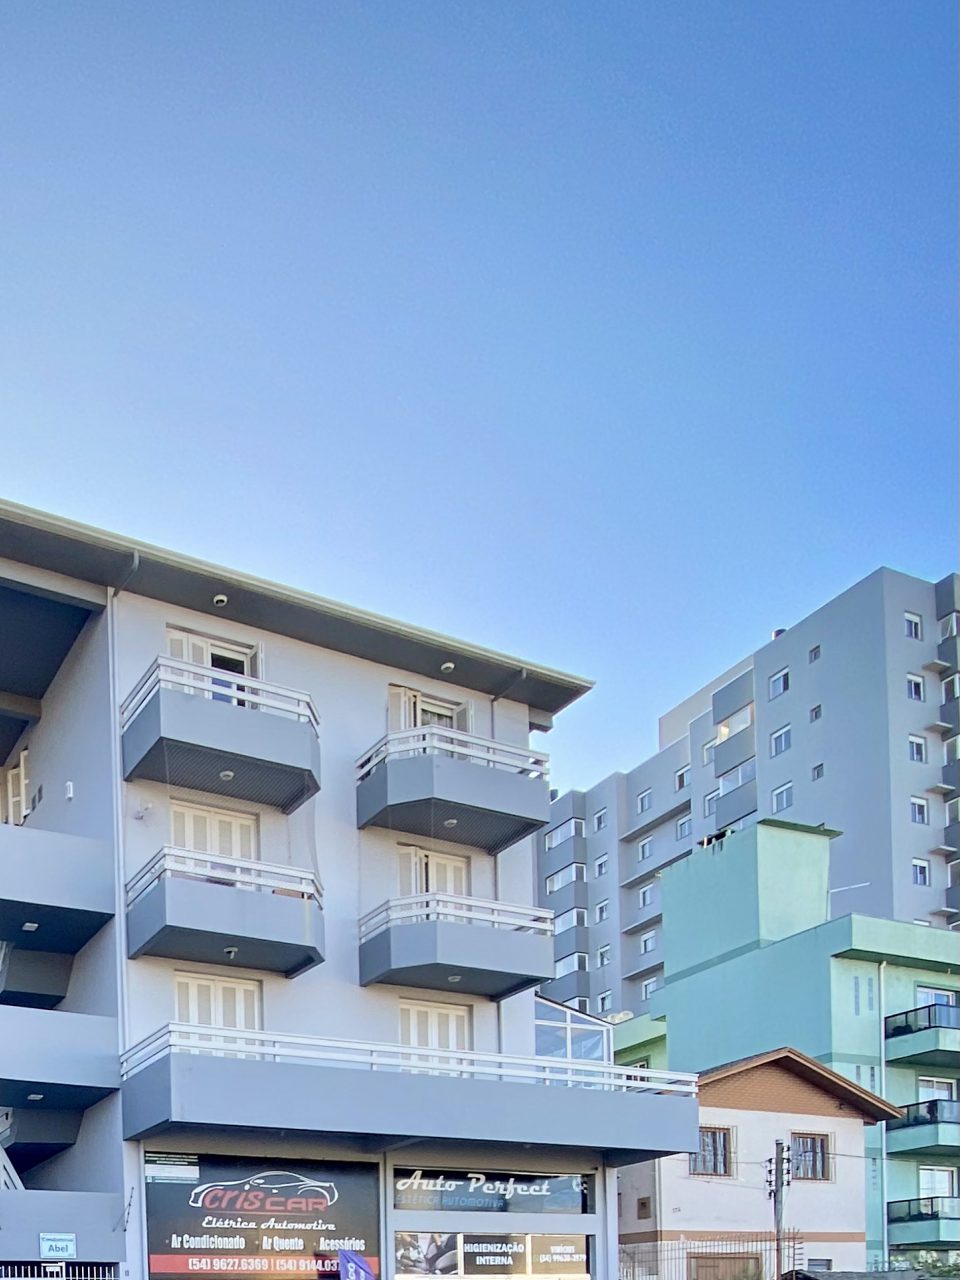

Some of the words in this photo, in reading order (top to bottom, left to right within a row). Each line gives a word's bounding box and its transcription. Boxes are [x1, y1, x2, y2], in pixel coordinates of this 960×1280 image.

[396, 1170, 464, 1192] Auto
[466, 1173, 551, 1199] Perfect
[202, 1216, 257, 1229] Elétrica
[261, 1218, 336, 1231] Automotiva
[48, 1244, 69, 1253] Abel
[171, 1234, 181, 1248] Ar
[183, 1234, 246, 1249] Condicionado
[262, 1235, 272, 1250] Ar
[273, 1236, 304, 1251] Quente
[320, 1237, 366, 1251] Acessórios
[464, 1241, 525, 1255] HIGIENIZAÇÃO
[188, 1258, 210, 1270] (54)
[213, 1258, 268, 1271] 9627.6369
[276, 1259, 297, 1271] (54)
[475, 1255, 513, 1265] INTERNA
